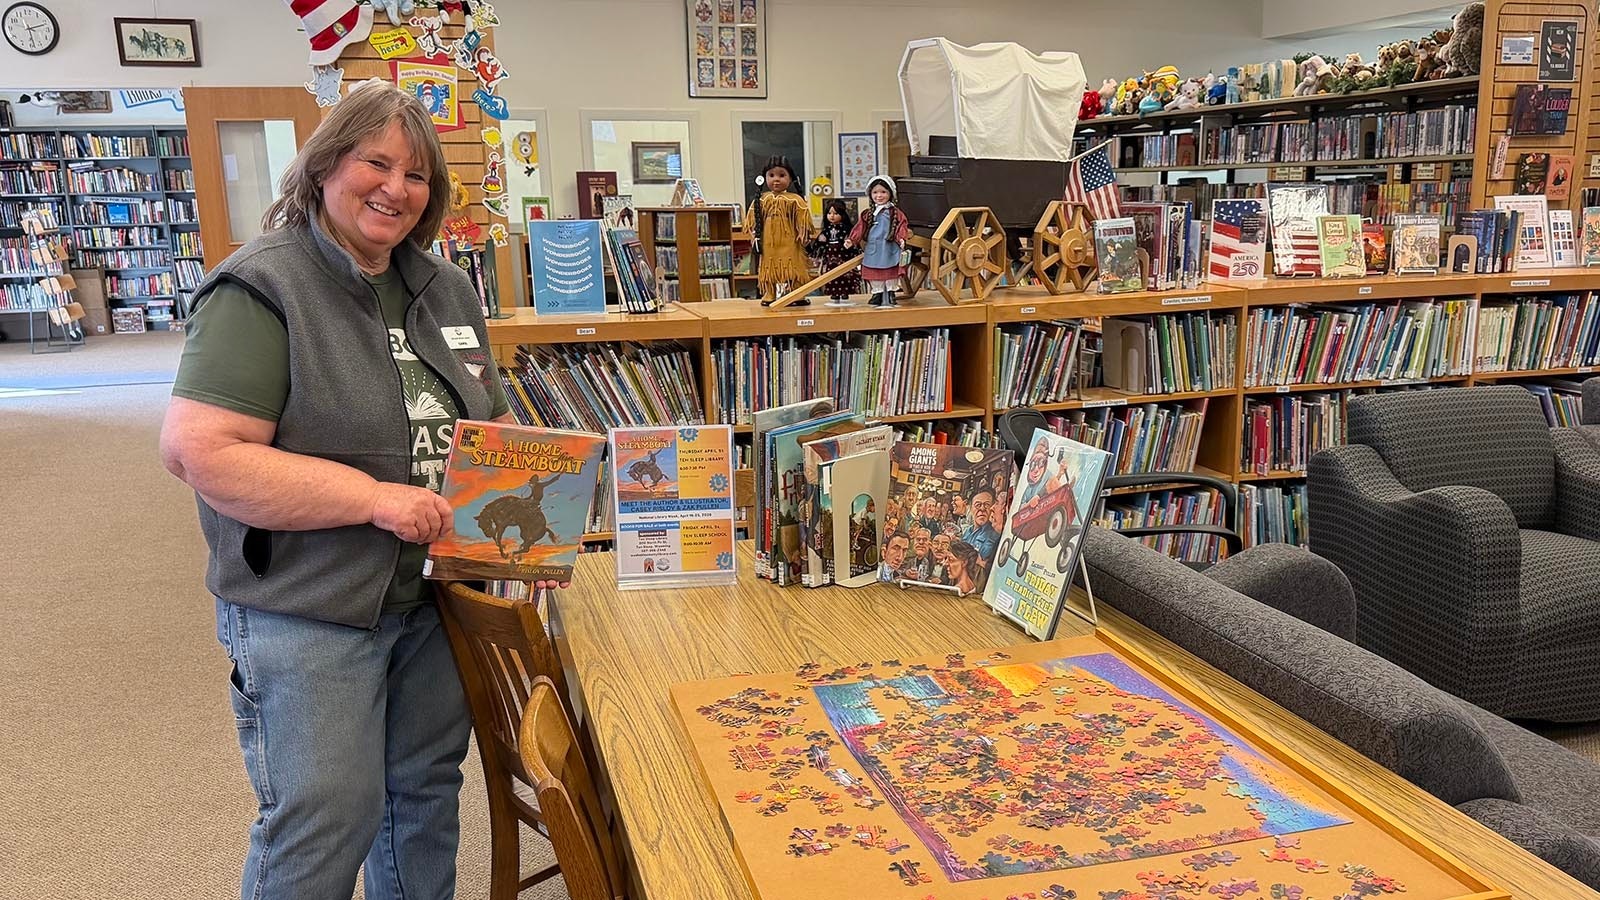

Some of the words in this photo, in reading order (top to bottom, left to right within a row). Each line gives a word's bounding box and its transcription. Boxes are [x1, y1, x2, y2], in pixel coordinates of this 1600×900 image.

[378, 43, 400, 55] here
[473, 92, 496, 112] there?
[1546, 99, 1569, 110] LOUDER
[450, 216, 469, 230] Say!
[1103, 227, 1134, 237] SURVIVED
[542, 236, 590, 249] WONDERBOOKS
[543, 246, 590, 258] WONDERBOOKS
[544, 255, 592, 267] WONDERBOOKS
[545, 264, 592, 276] WONDERBOOKS
[1232, 261, 1259, 276] 250
[546, 273, 593, 284] WONDERBOOKS
[546, 282, 594, 294] WONDERBOOKS
[412, 424, 453, 456] AS
[617, 441, 672, 450] STEAMBOAT
[504, 440, 514, 452] A
[518, 442, 562, 456] HOME
[911, 447, 937, 456] AMONG
[470, 450, 585, 474] STEAMBOAT
[909, 455, 937, 465] GIANTS
[1024, 570, 1058, 600] FRIDAY
[1013, 581, 1035, 600] RADIO
[1032, 594, 1055, 613] FLYER
[1016, 598, 1050, 630] FLEW
